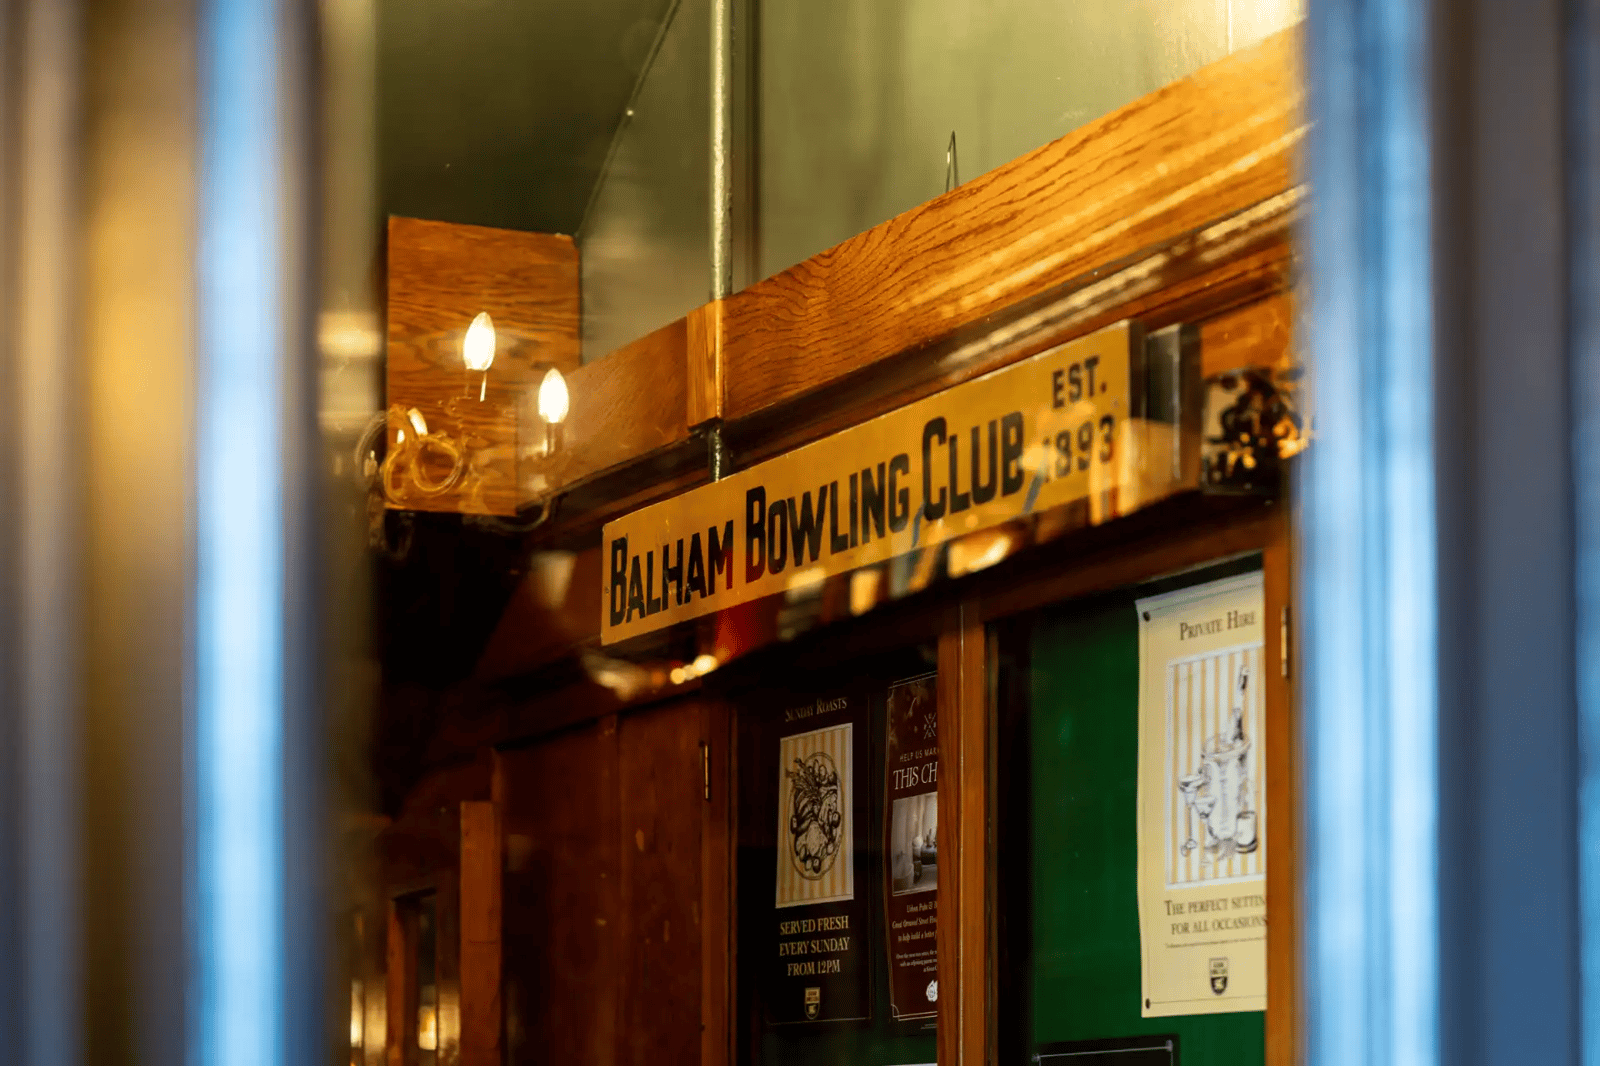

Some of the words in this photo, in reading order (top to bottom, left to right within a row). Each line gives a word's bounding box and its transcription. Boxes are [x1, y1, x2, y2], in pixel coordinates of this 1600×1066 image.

[1052, 355, 1107, 409] EST.
[609, 519, 734, 627] BALHAM
[745, 453, 911, 583] BOWLING
[921, 410, 1025, 522] CLUB
[1180, 618, 1224, 641] PRIVATE
[816, 696, 848, 715] ROASTS
[893, 766, 919, 790] THIS
[920, 761, 938, 784] CH
[1164, 899, 1185, 916] THE
[1187, 898, 1228, 914] PERFECT
[780, 919, 816, 935] SERVED
[817, 915, 850, 932] FRESH
[1171, 921, 1190, 935] FOR
[1192, 919, 1209, 933] ALL
[779, 940, 810, 957] EVERY
[811, 936, 850, 953] SUNDAY
[787, 962, 815, 976] FROM
[817, 959, 841, 974] 12PM
